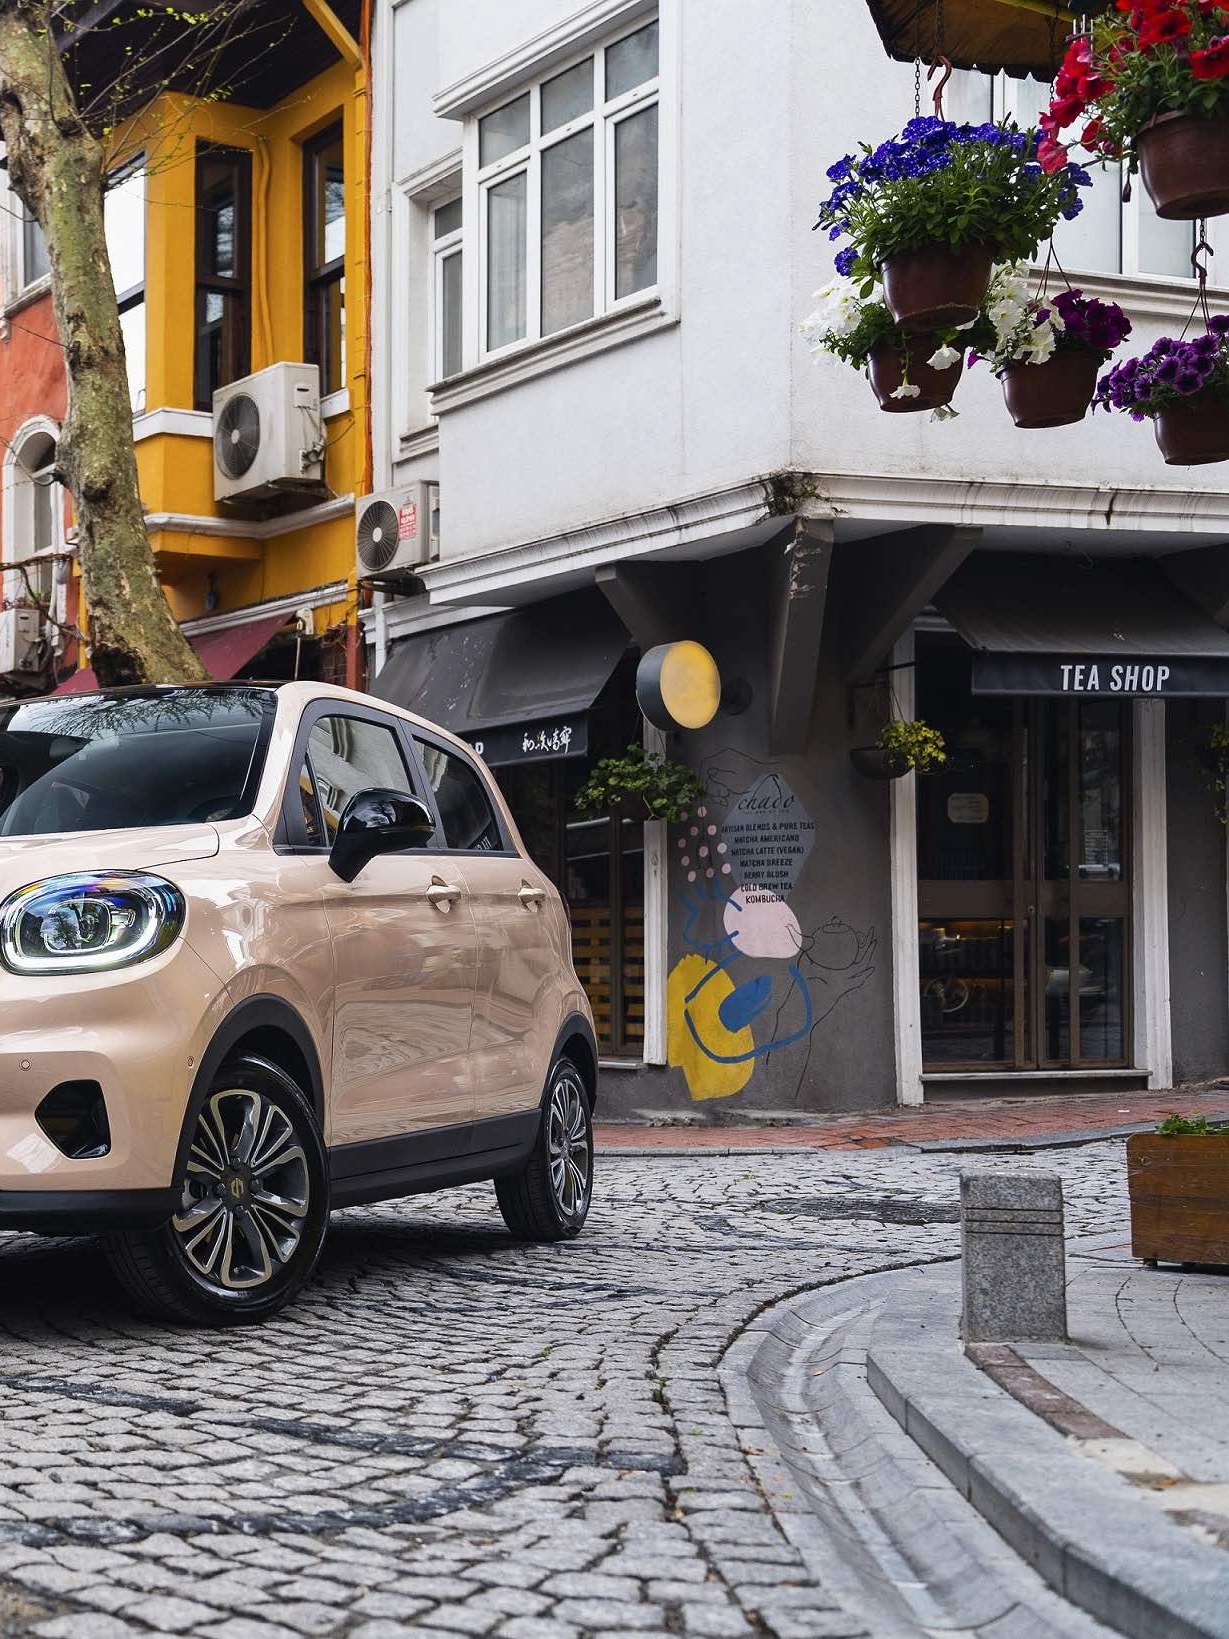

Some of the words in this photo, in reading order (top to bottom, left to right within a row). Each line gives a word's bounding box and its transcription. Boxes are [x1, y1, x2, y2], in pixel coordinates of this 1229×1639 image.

[1061, 665, 1100, 691] TEA
[1110, 665, 1170, 691] SHOP
[745, 823, 770, 832] BLENDS
[772, 822, 777, 831] &
[779, 822, 798, 831] PURE
[799, 821, 815, 830] TEAS
[734, 835, 758, 844] MATCHA
[759, 834, 800, 843] AMERICANO
[731, 848, 755, 857] MATCHA
[755, 847, 775, 856] LATTE
[776, 846, 804, 855] (VEGAN)
[739, 859, 765, 868] MATCHA
[766, 858, 793, 867] BREEZE
[744, 871, 765, 880] BERRY
[766, 870, 789, 879] BLUSH
[740, 884, 757, 893] COLD
[758, 882, 779, 891] BREW
[780, 881, 793, 891] TEA
[745, 894, 785, 905] KOMBUCHA
